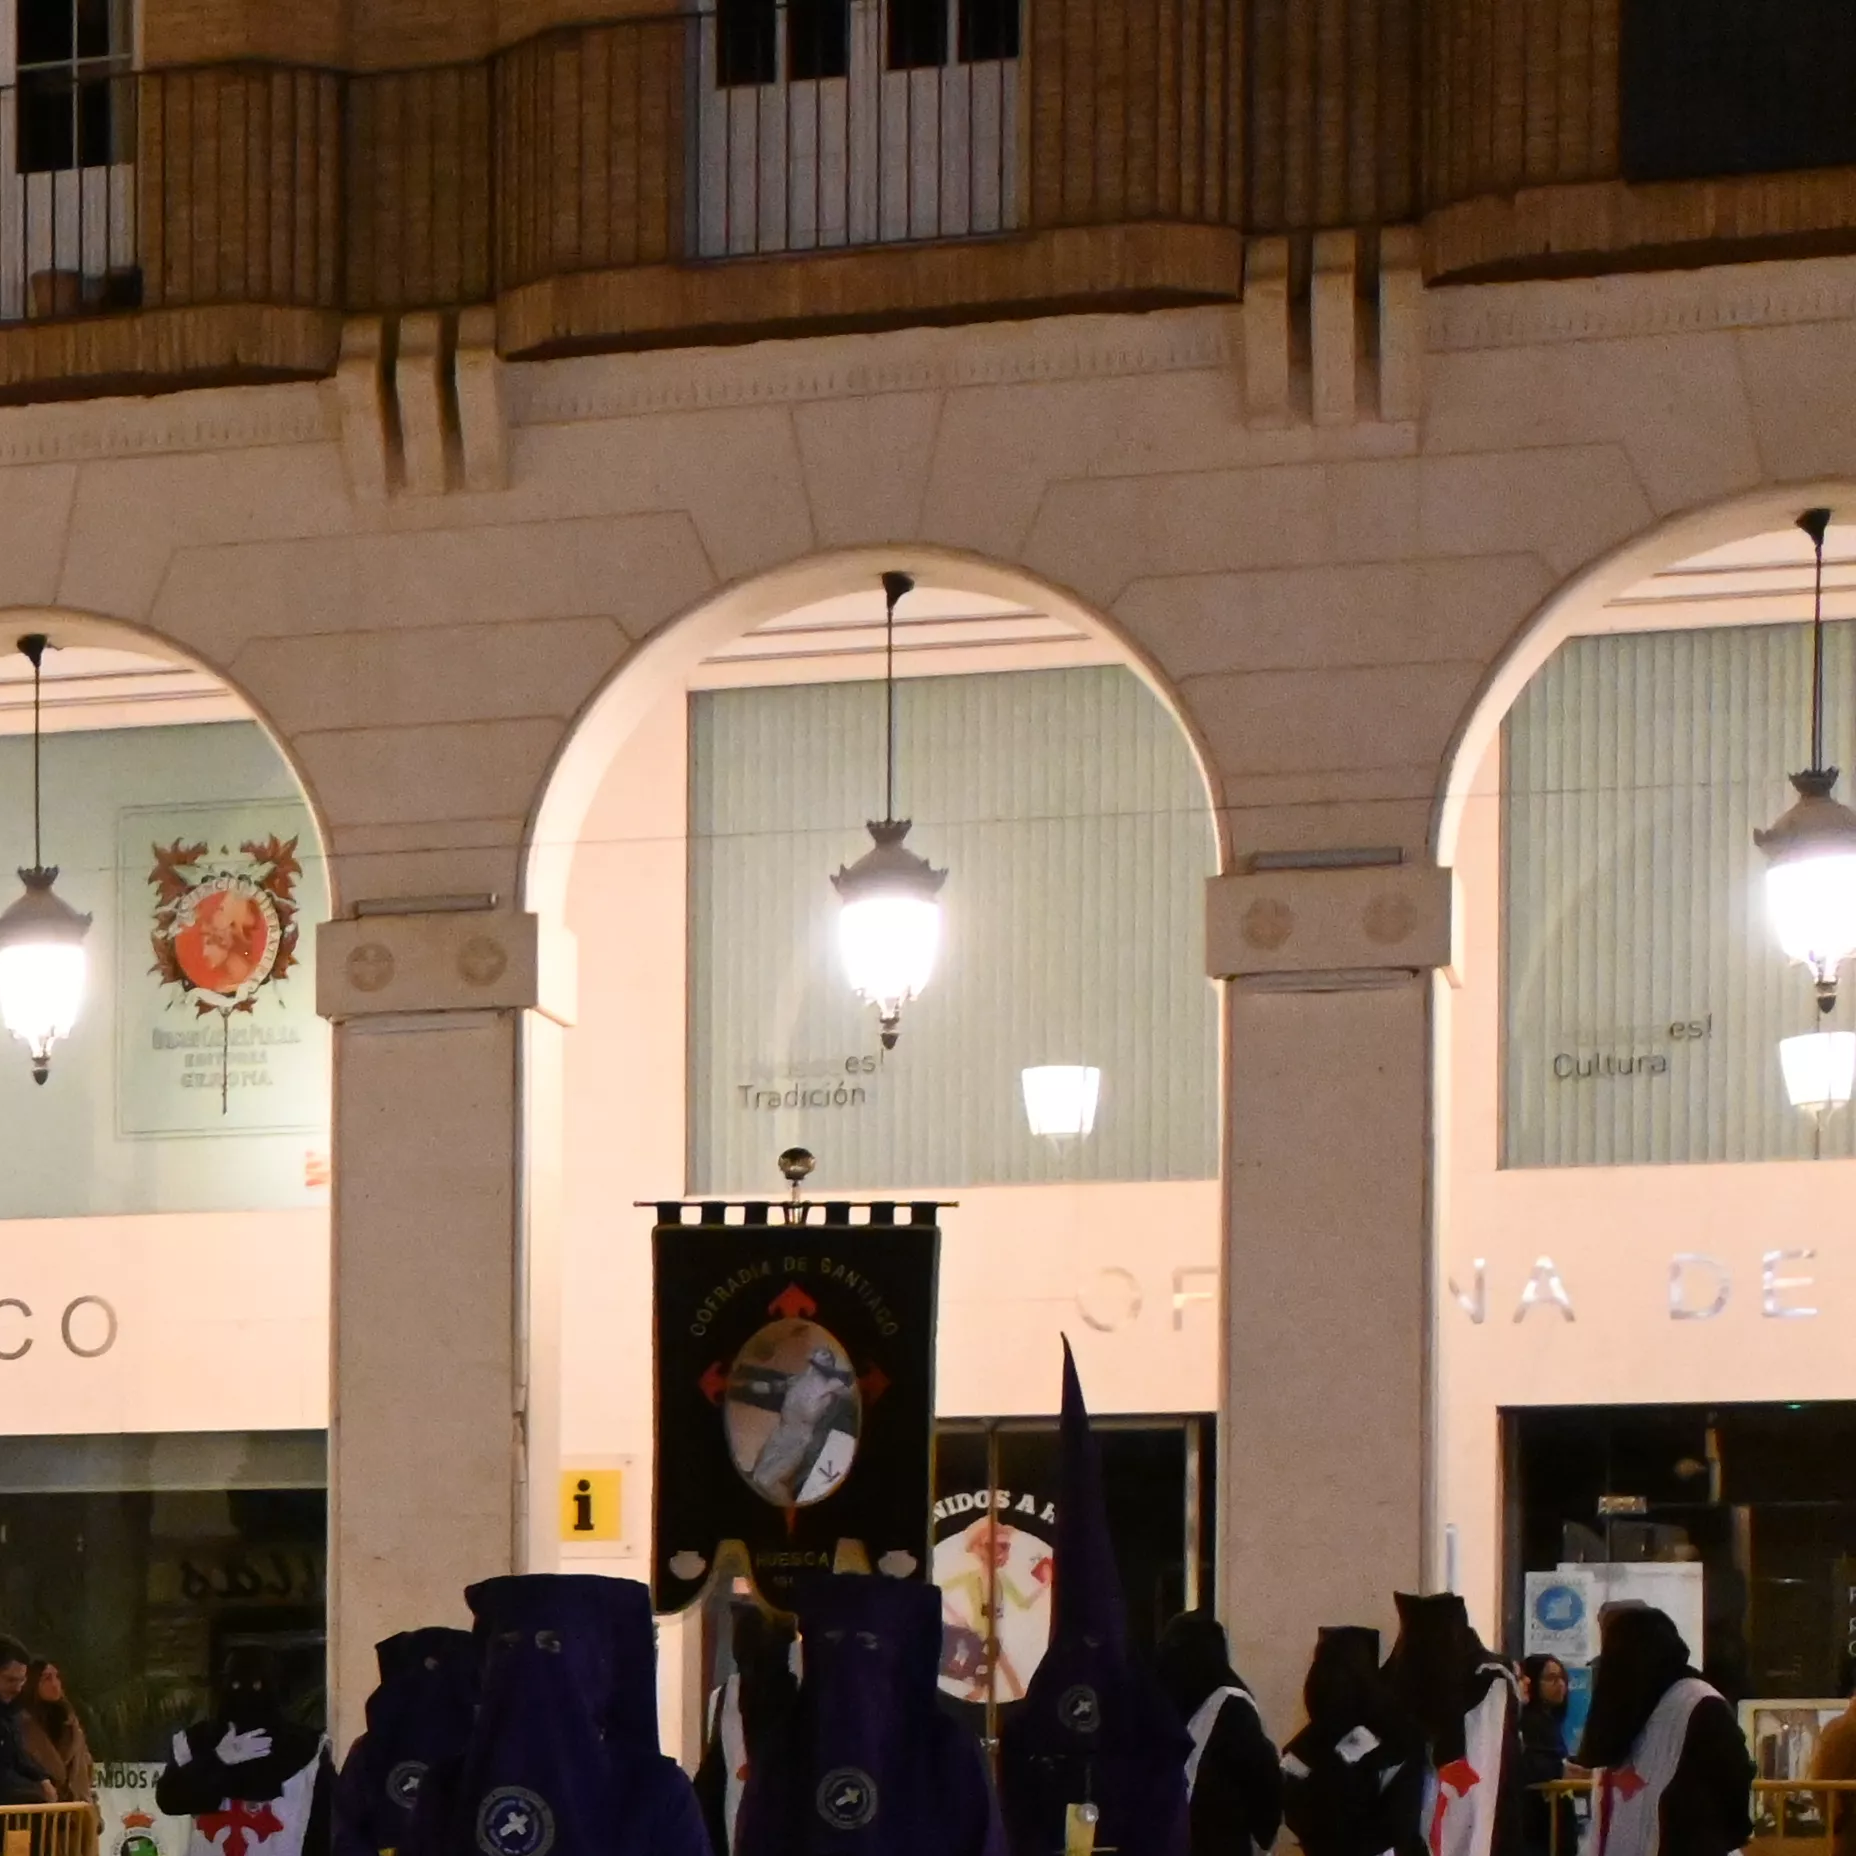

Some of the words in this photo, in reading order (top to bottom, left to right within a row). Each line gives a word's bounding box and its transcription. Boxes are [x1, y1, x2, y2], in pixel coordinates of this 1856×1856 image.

[1553, 1052, 1667, 1079] Cultura
[737, 1081, 867, 1111] Tradición
[690, 1259, 772, 1338] COFRADIA
[783, 1255, 809, 1273] DE
[820, 1257, 899, 1336] SANTIAGO
[1667, 1248, 1819, 1321] DE
[1014, 1493, 1036, 1516] A
[755, 1551, 830, 1568] HUESCA
[91, 1770, 148, 1789] NIDOS
